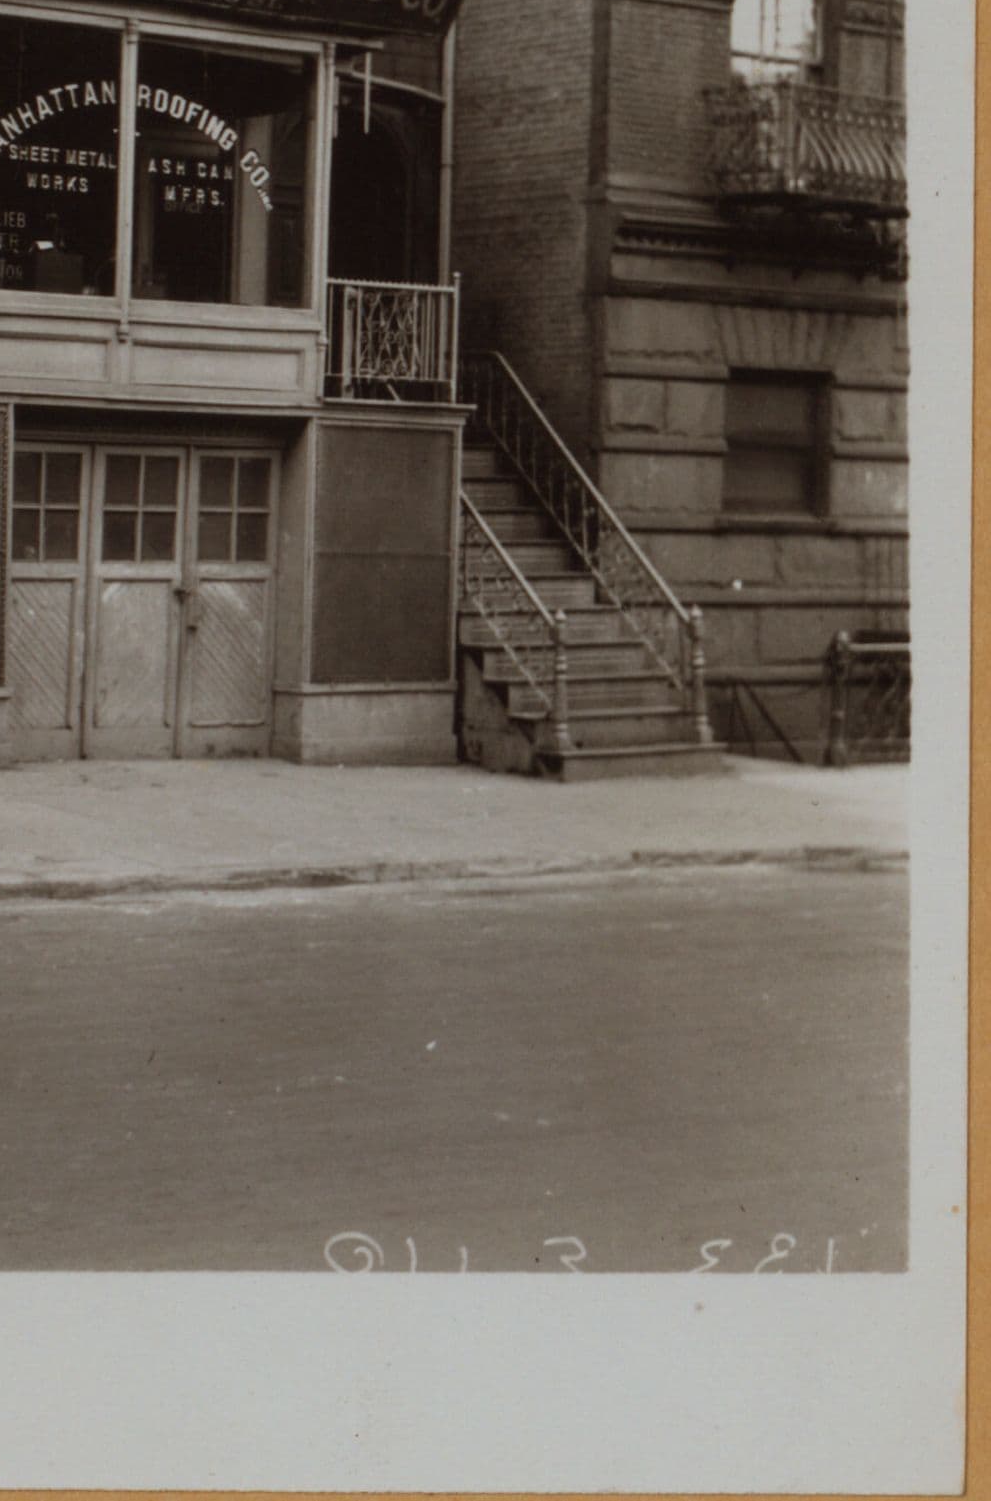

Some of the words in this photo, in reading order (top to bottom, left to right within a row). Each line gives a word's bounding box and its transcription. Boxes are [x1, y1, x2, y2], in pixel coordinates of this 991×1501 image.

[136, 84, 238, 152] ROOFING
[8, 143, 59, 166] SHEET
[65, 147, 117, 170] METAL
[147, 157, 187, 176] ASH
[197, 162, 234, 181] CAN
[26, 172, 90, 194] WORKS
